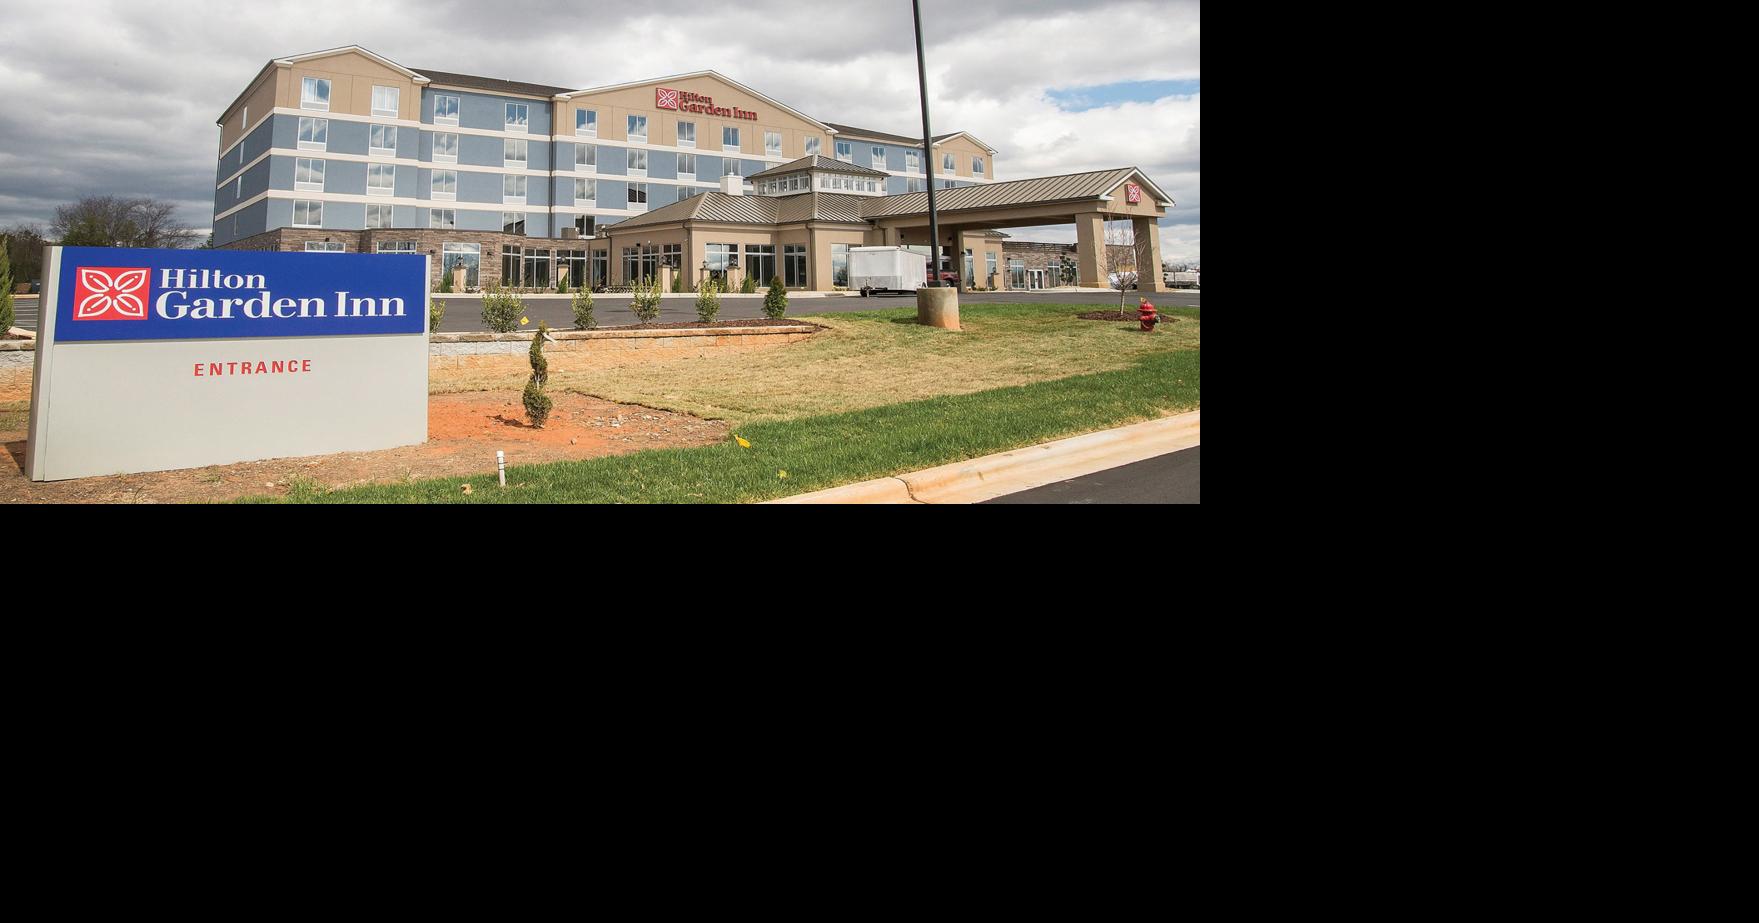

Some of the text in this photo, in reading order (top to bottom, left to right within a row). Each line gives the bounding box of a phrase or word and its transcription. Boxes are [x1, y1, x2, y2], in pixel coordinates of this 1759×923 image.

[679, 91, 712, 104] Hilton
[679, 101, 758, 121] Garden Inn
[158, 268, 267, 289] Hilton
[156, 290, 407, 320] Garden Inn
[194, 359, 312, 377] ENTRANCE
